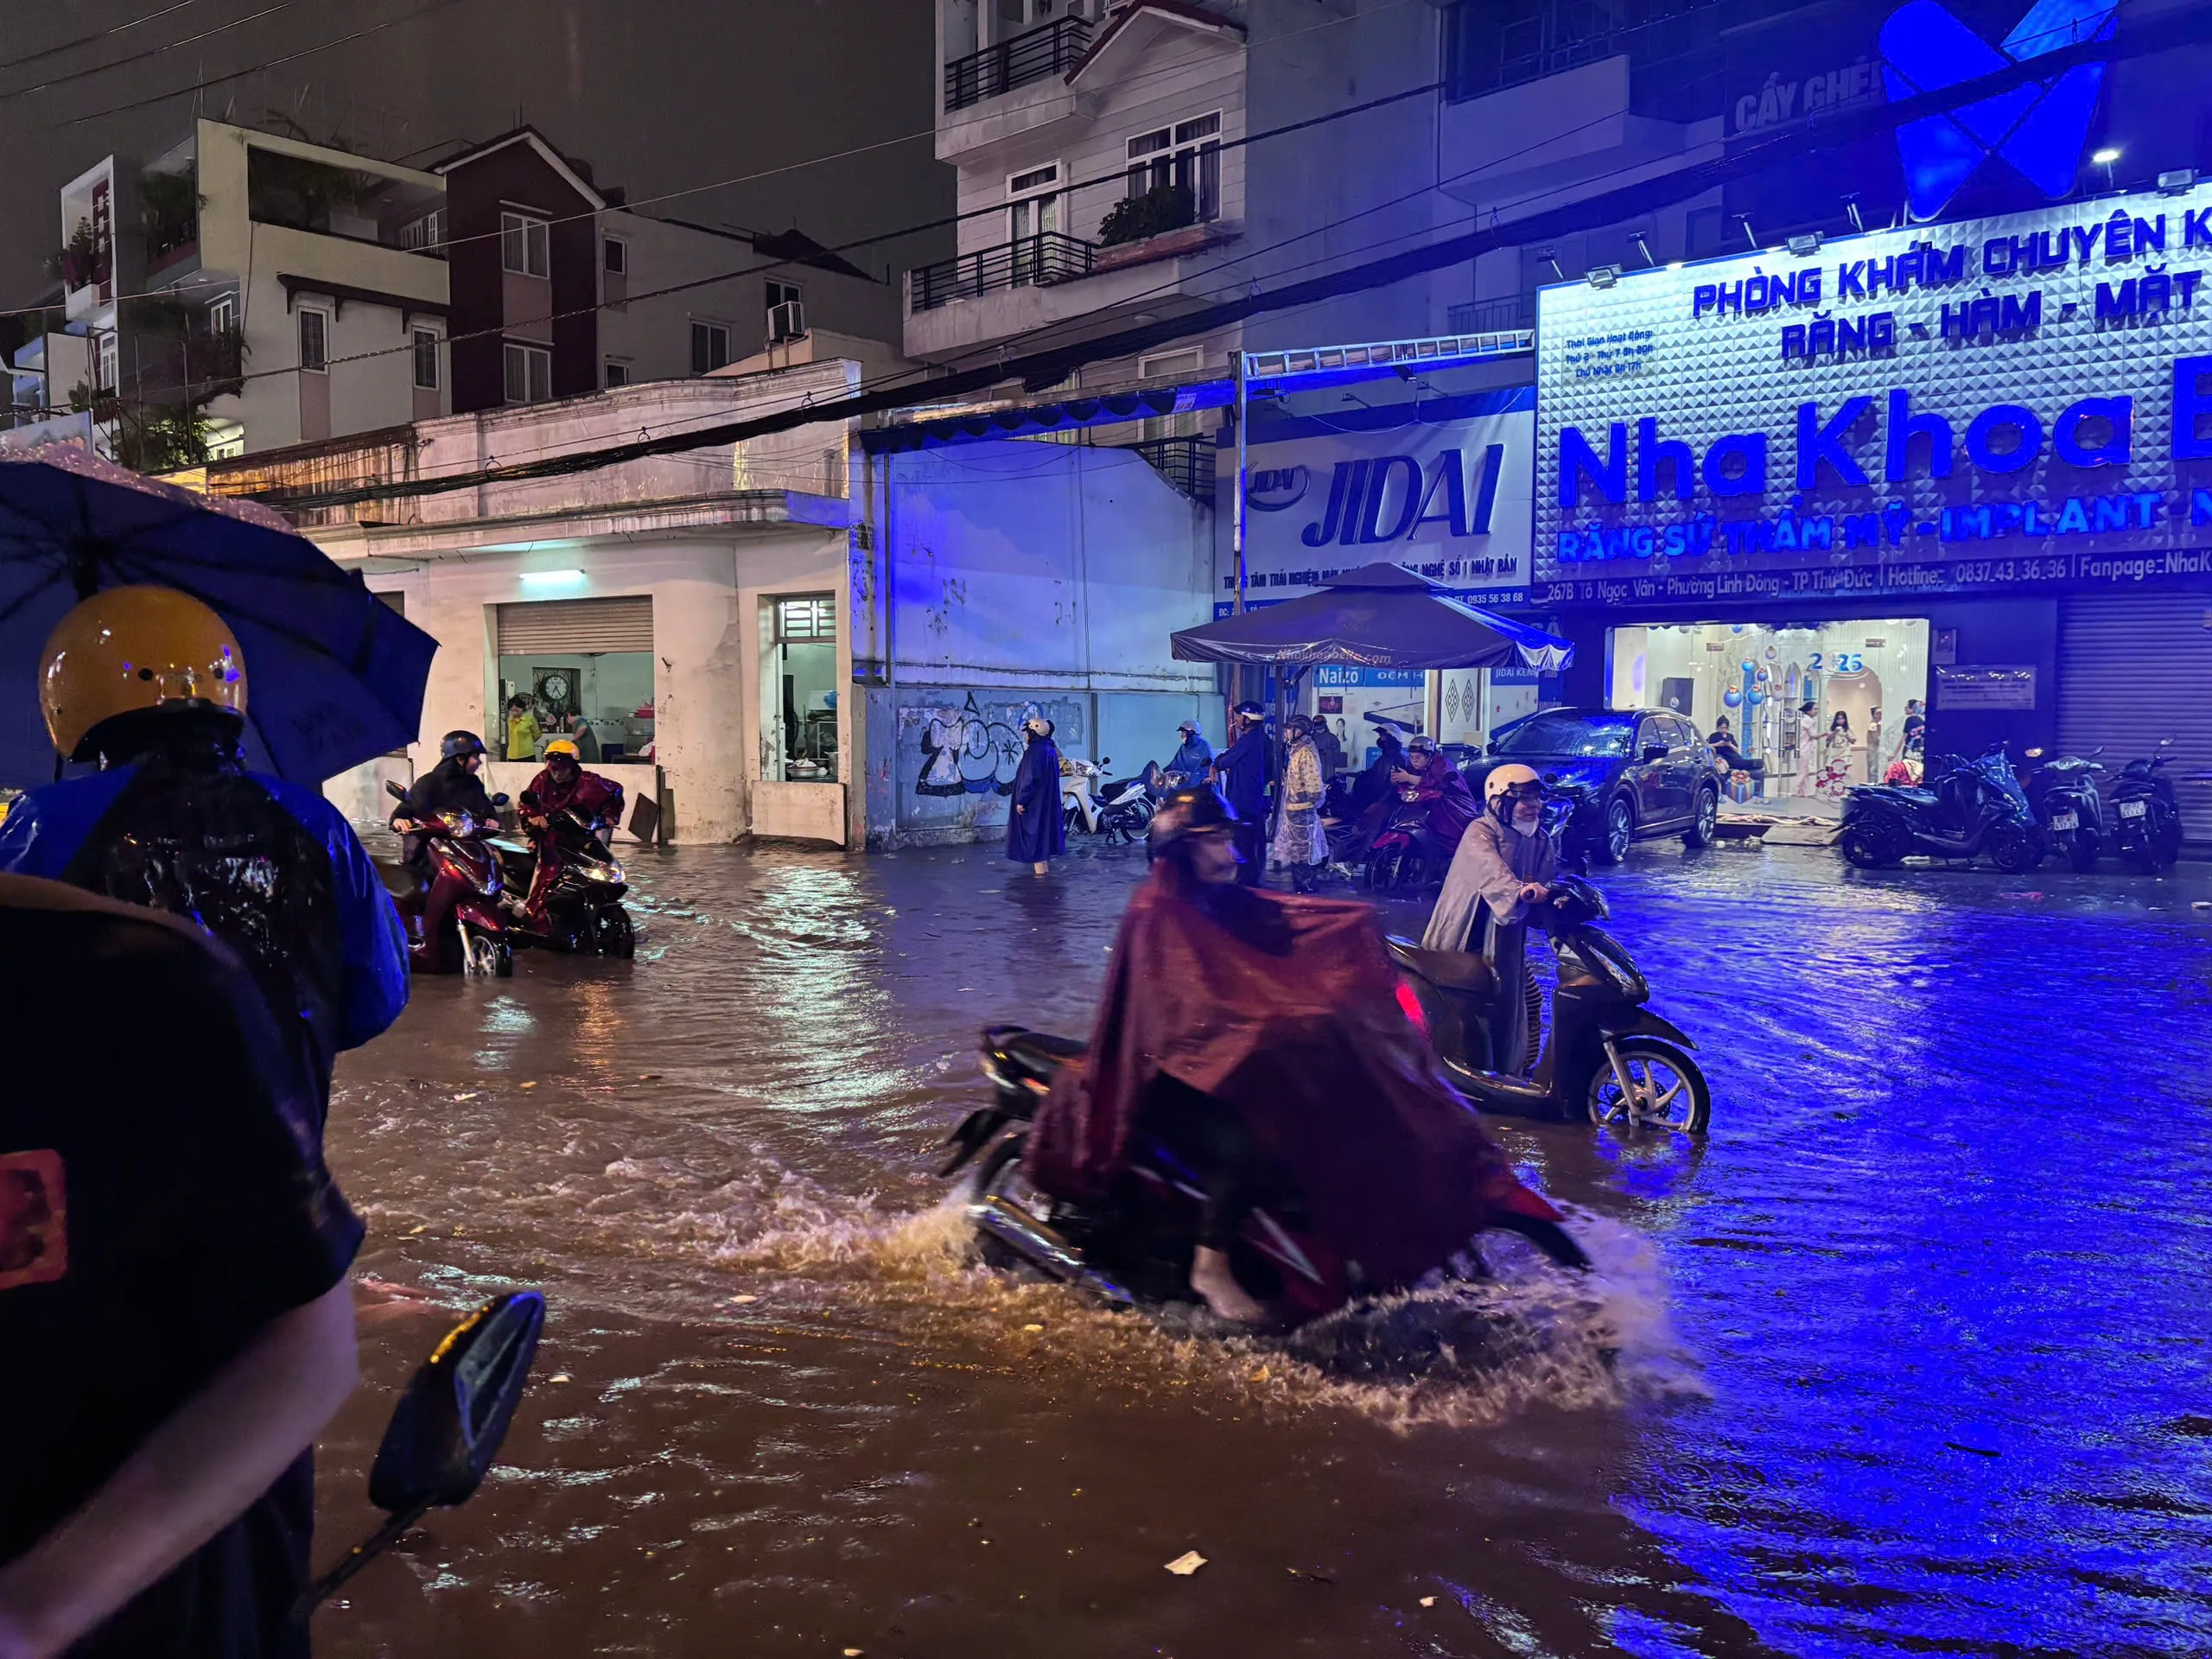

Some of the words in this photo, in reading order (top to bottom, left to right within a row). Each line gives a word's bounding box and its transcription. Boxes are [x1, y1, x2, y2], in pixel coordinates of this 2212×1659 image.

[1693, 266, 1822, 317] PHÒNG
[1838, 240, 1966, 296] KHÁM
[1982, 209, 2165, 274] CHUYÊN
[1782, 309, 1894, 359] RĂNG
[1941, 287, 2042, 338] HÀM
[2095, 263, 2202, 320] MẶT
[1587, 336, 1605, 346] Gian
[1607, 333, 1626, 345] Hoạt
[1597, 349, 1613, 359] Thứ
[1616, 348, 1620, 357] 7
[1593, 365, 1612, 375] Nhật
[1559, 416, 1766, 508] Nha
[1796, 388, 2134, 490] Khoa
[1301, 442, 1505, 547] JIDAI
[1558, 522, 1654, 563] RĂNG
[1663, 511, 1715, 556] SỨ
[1720, 495, 1834, 554] THẨM
[1846, 500, 1910, 550] MỸ
[1940, 490, 2163, 543] IMPLANT
[1250, 571, 1266, 588] TÂM
[1269, 568, 1287, 587] TRẢI
[1421, 559, 1445, 580] NGHỆ
[1449, 554, 1460, 575] SỐ
[1464, 561, 1468, 575] 1
[1471, 556, 1495, 576] NHẬT
[1497, 553, 1518, 573] BẢN
[1548, 582, 1574, 601] 267B
[1598, 580, 1628, 606] Ngọc
[1633, 576, 1656, 597] Vân
[1667, 575, 1714, 600] Phường
[1717, 572, 1743, 594] Linh
[1745, 574, 1779, 597] Đông
[1792, 570, 1808, 591] TP
[1812, 569, 1837, 590] Thủ
[1844, 567, 1872, 589] Đức
[1467, 594, 1487, 605] 0935
[1489, 594, 1499, 603] 56
[1500, 593, 1511, 602] 38
[1512, 592, 1524, 602] 68
[1496, 668, 1515, 678] JIDAI
